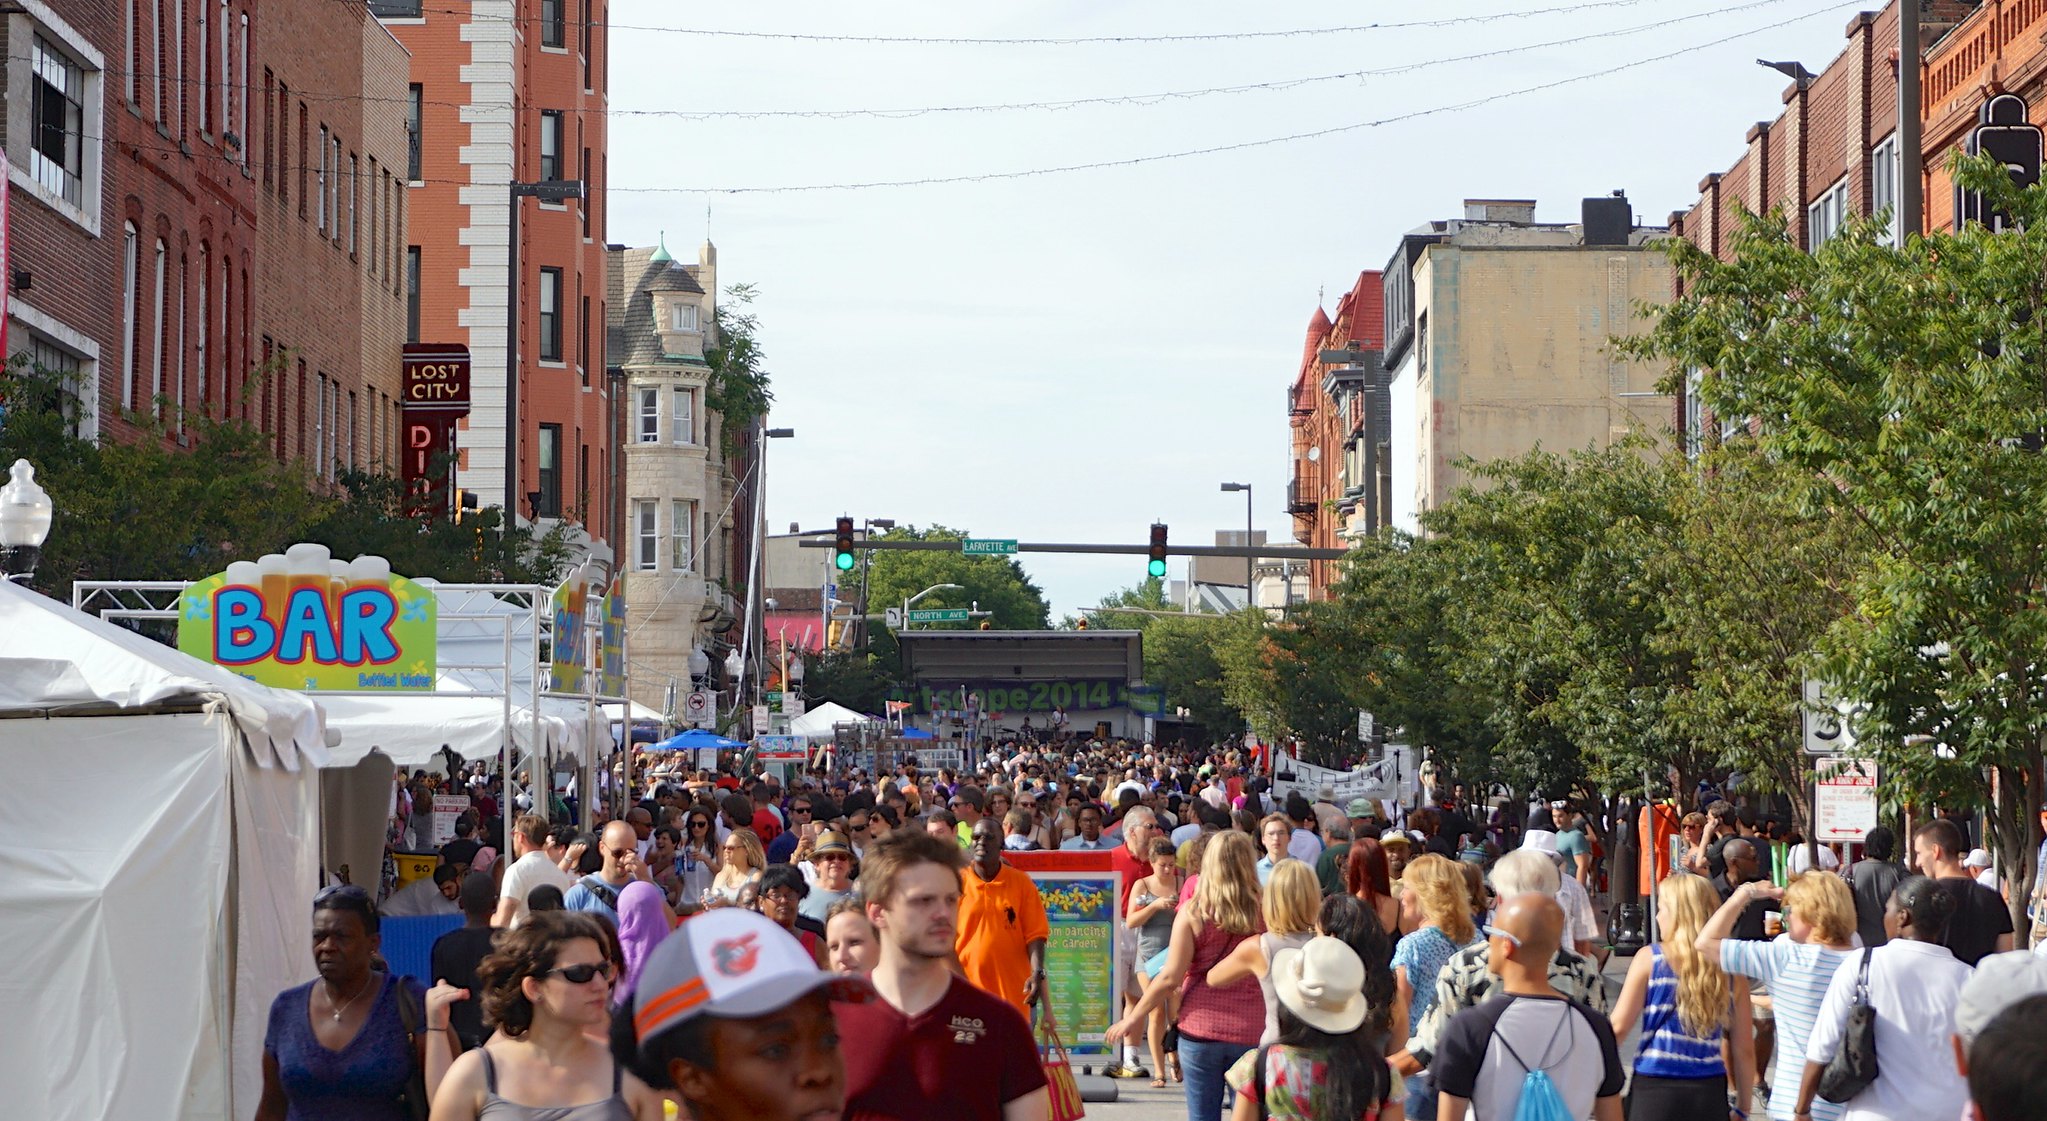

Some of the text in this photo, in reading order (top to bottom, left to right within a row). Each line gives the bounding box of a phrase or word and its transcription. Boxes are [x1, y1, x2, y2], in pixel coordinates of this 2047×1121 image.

[411, 364, 460, 380] LOST
[411, 383, 460, 399] CITY
[964, 541, 1004, 551] LAFAYETTE
[913, 611, 942, 620] NORTH
[213, 584, 402, 667] BAR
[359, 672, 432, 687] Bottled Water
[951, 1014, 984, 1028] HCO
[954, 1030, 976, 1045] 22
